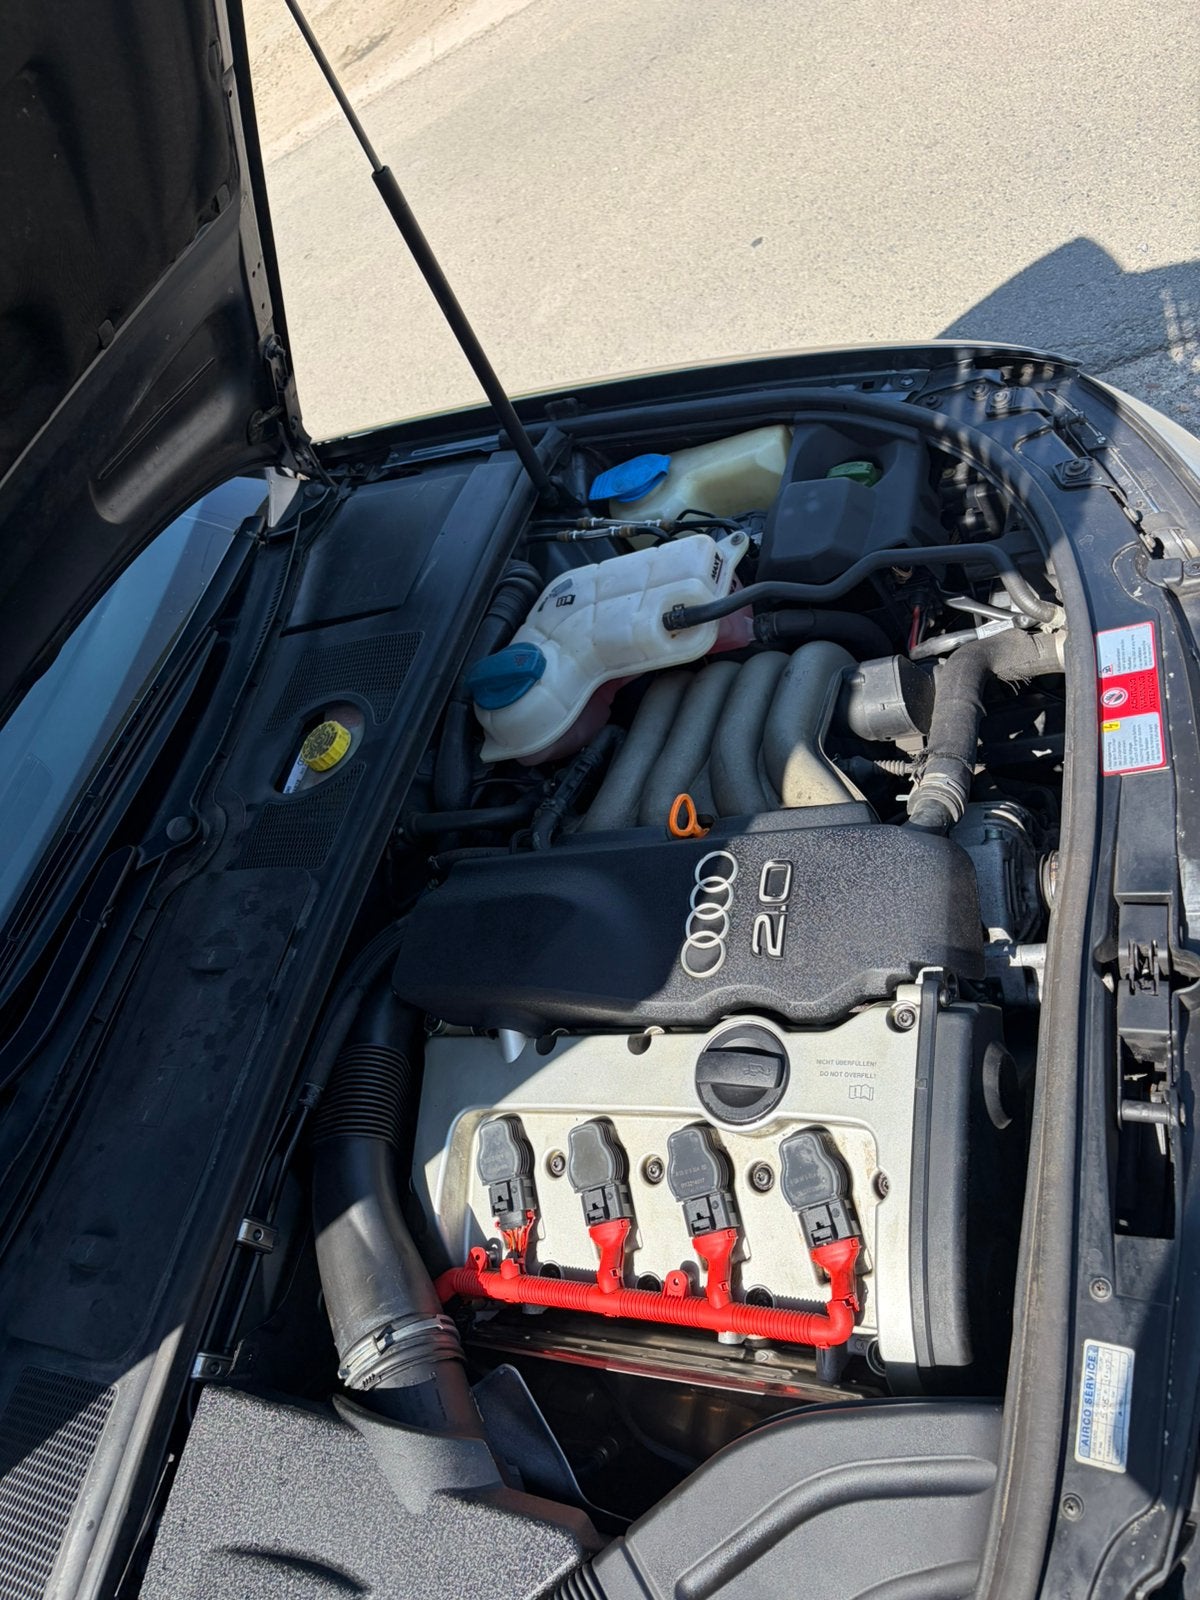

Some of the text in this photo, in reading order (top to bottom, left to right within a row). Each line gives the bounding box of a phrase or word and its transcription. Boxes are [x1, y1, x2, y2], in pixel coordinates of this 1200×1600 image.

[1130, 677, 1138, 710] ACHTUNG
[1149, 672, 1157, 710] ATTENTION
[1081, 1354, 1098, 1447] AIRCO SERVICE
